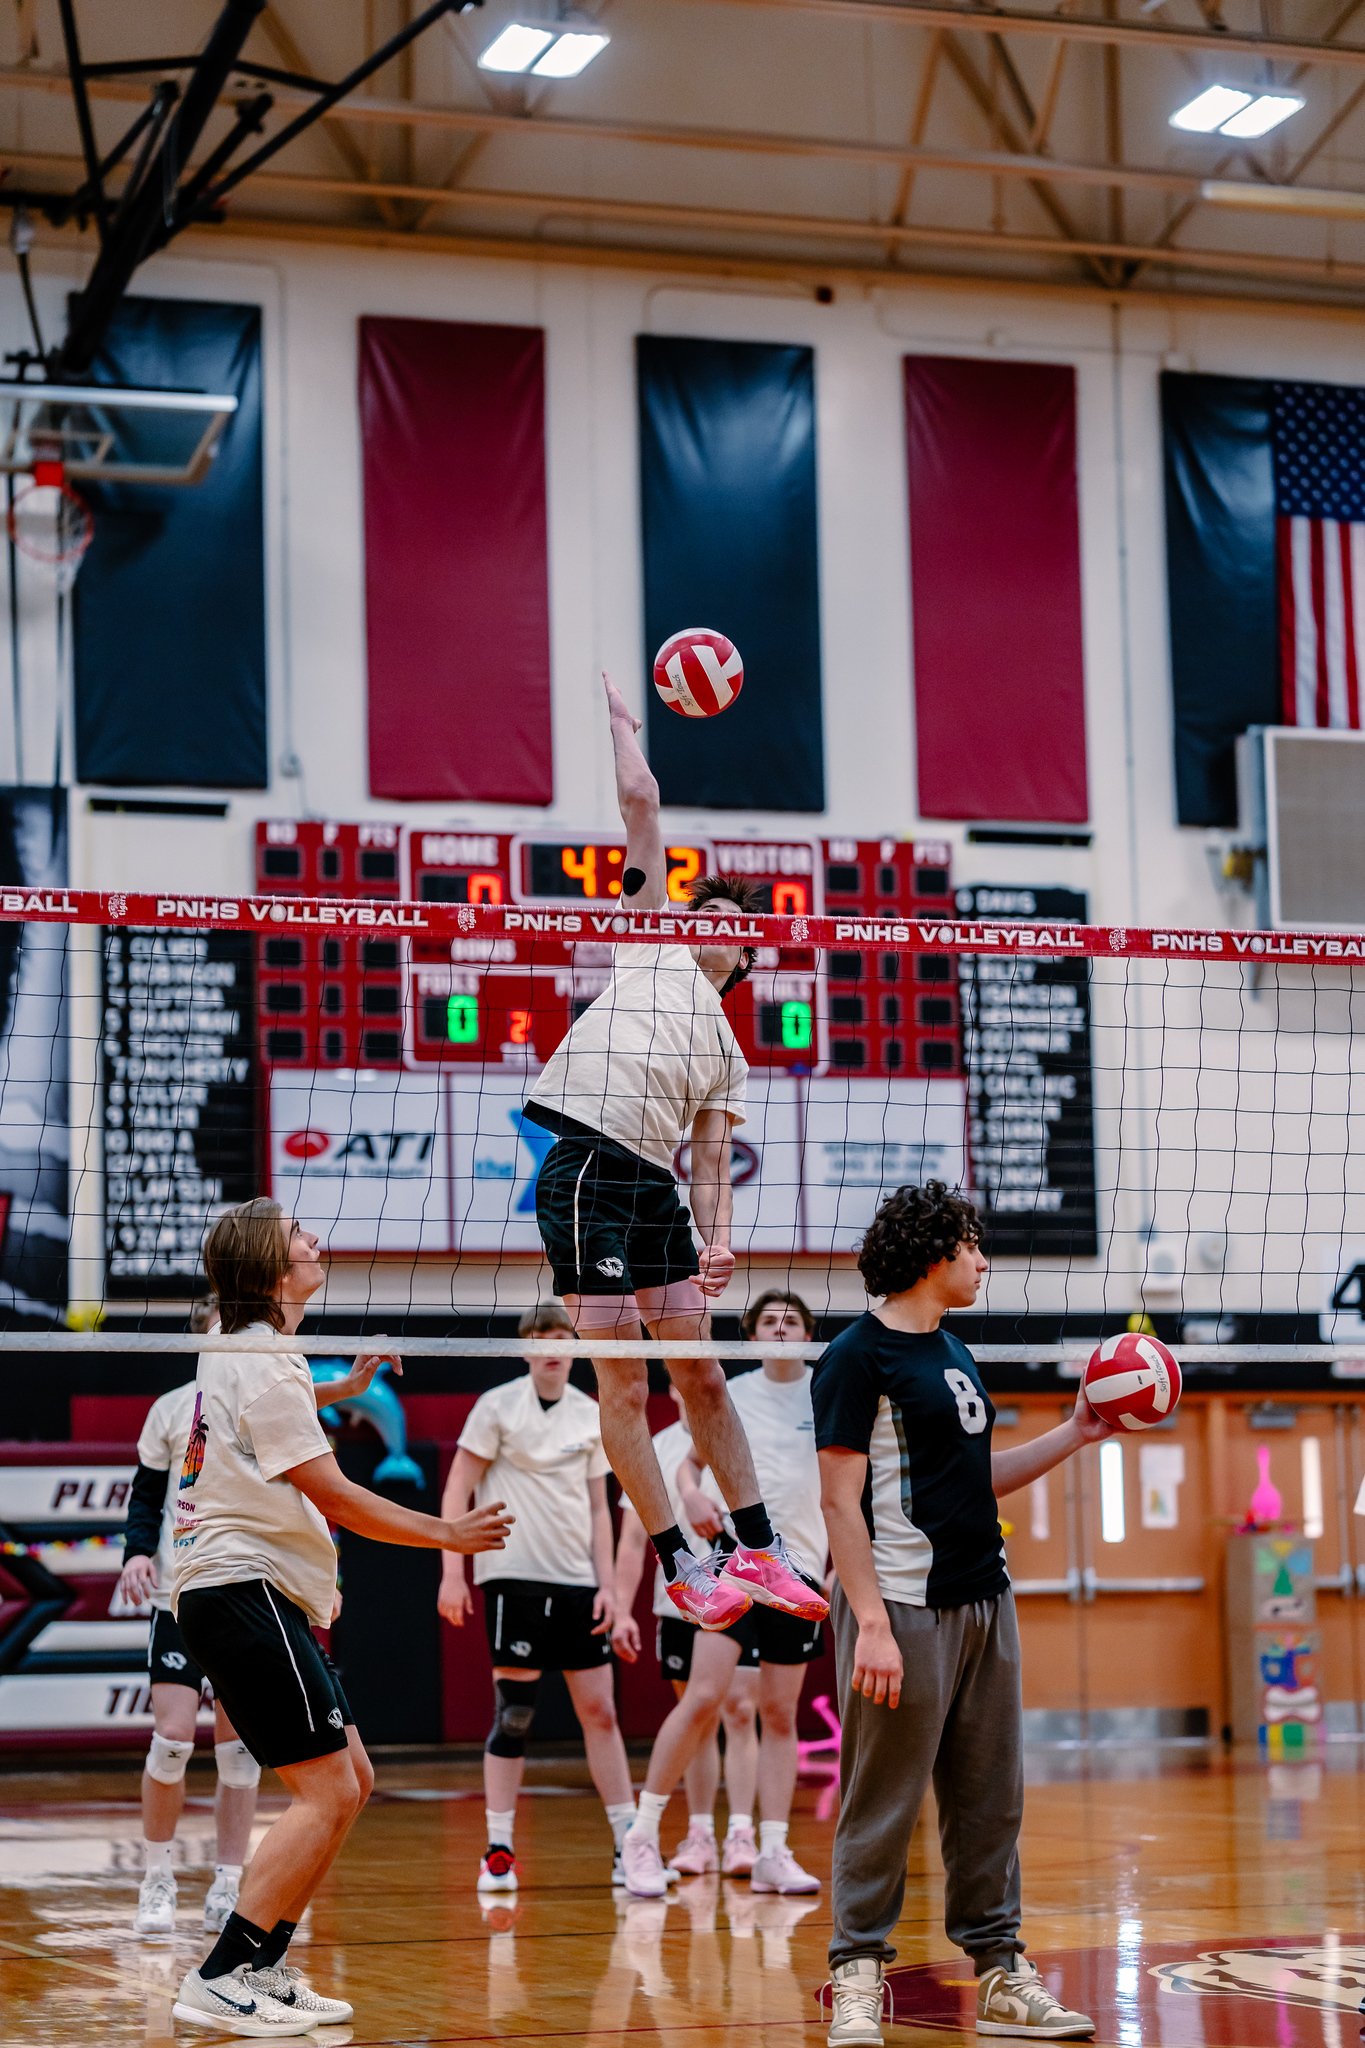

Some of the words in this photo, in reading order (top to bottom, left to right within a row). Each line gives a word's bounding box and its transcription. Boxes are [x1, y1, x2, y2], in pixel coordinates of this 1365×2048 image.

[421, 835, 499, 867] HOME
[716, 843, 812, 874] VISITOR
[0, 894, 78, 913] BALL
[157, 900, 240, 920] PNHS
[248, 903, 428, 928] VOLLEYBALL
[504, 912, 582, 932] PNHS
[590, 915, 764, 938] VOLLEYBALL
[836, 924, 910, 943] PNHS
[919, 925, 1084, 948] VOLLEYBALL
[1152, 933, 1223, 952] PNHS
[336, 1130, 432, 1161] ATI
[944, 1368, 987, 1435] 8
